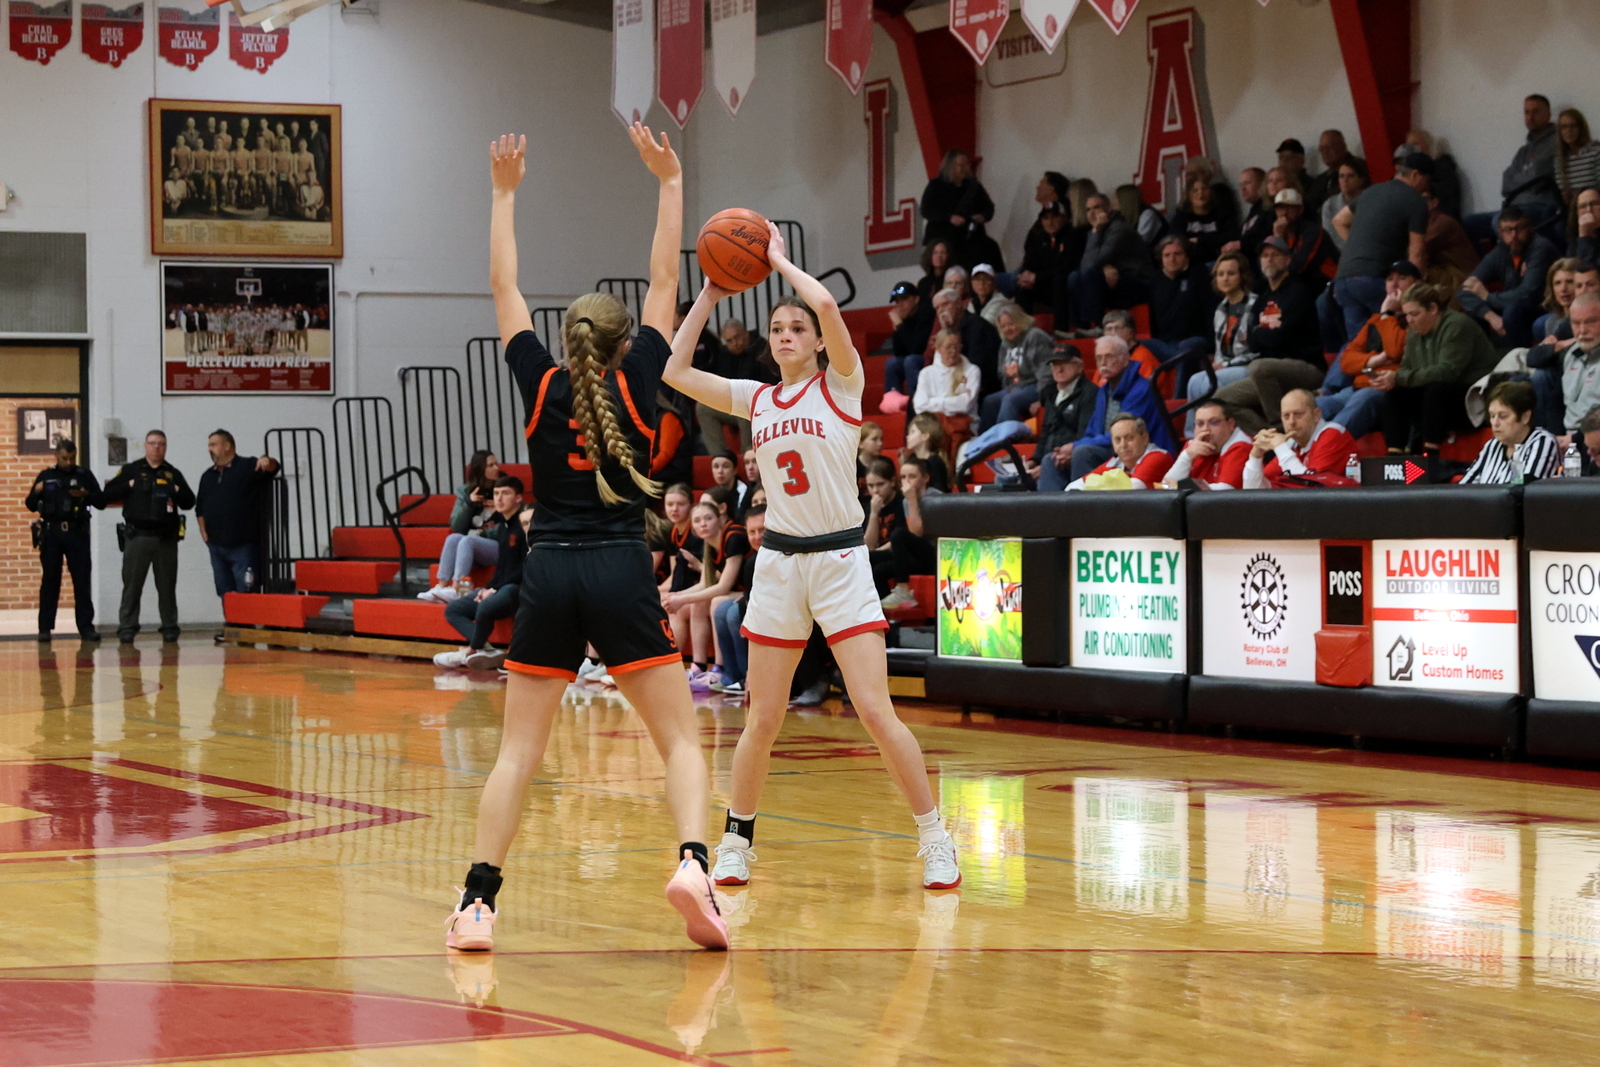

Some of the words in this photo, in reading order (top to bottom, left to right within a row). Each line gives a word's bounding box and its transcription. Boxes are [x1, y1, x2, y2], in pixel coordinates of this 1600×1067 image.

[28, 25, 53, 35] CHAD
[100, 27, 124, 37] GREG
[174, 30, 203, 41] KELLY
[22, 33, 59, 44] BEAMER
[100, 36, 125, 47] KEYS
[171, 38, 207, 50] BEAMER
[240, 33, 278, 44] JEFFERY
[37, 47, 47, 59] B
[242, 41, 277, 53] PELTON
[996, 34, 1044, 60] VISITO
[109, 50, 118, 62] B
[185, 53, 195, 65] B
[255, 56, 265, 69] B
[1134, 7, 1214, 214] A
[864, 77, 916, 256] L
[730, 225, 769, 252] awlings
[776, 449, 811, 497] 3
[1077, 550, 1180, 585] BECKLEY
[1385, 549, 1500, 577] LAUGHLIN
[1329, 570, 1362, 596] POSS
[1545, 563, 1600, 595] CRO
[1388, 580, 1449, 594] OUTDOOR
[1454, 581, 1498, 594] LIVING
[1137, 595, 1178, 621] HEATING
[1084, 630, 1099, 655] AIR
[1103, 631, 1173, 658] CONDITIONING
[1243, 644, 1264, 655] Rotary
[1266, 645, 1281, 654] Club
[1282, 646, 1289, 654] of
[1422, 642, 1449, 656] Level
[1453, 643, 1468, 661] Up
[1276, 659, 1287, 667] OH
[1422, 663, 1463, 678] Custom
[1466, 665, 1504, 680] Homes
